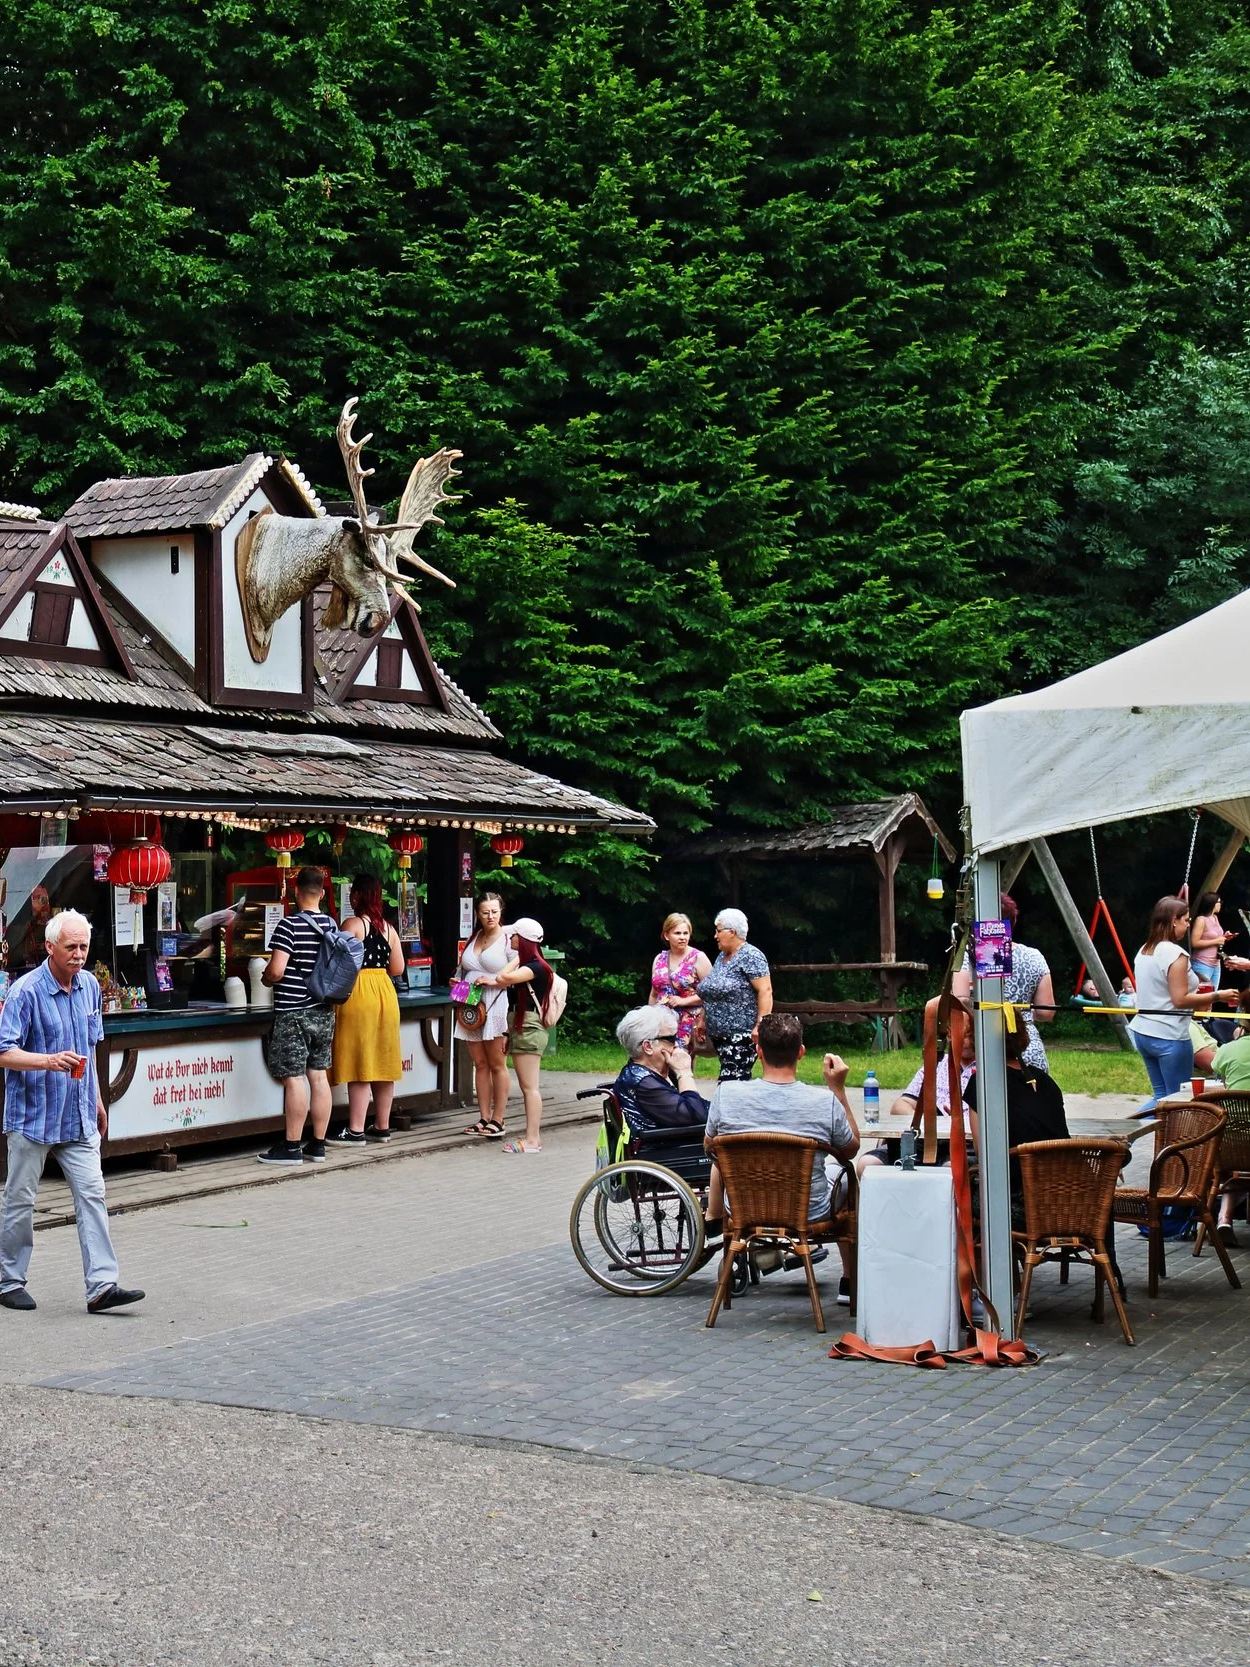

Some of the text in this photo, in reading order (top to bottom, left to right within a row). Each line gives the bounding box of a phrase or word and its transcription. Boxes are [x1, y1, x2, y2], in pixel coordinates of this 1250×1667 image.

[148, 1062, 164, 1081] Wat
[165, 1061, 174, 1080] de
[210, 1055, 234, 1074] kennt
[153, 1086, 167, 1106] dat
[170, 1084, 186, 1103] fret
